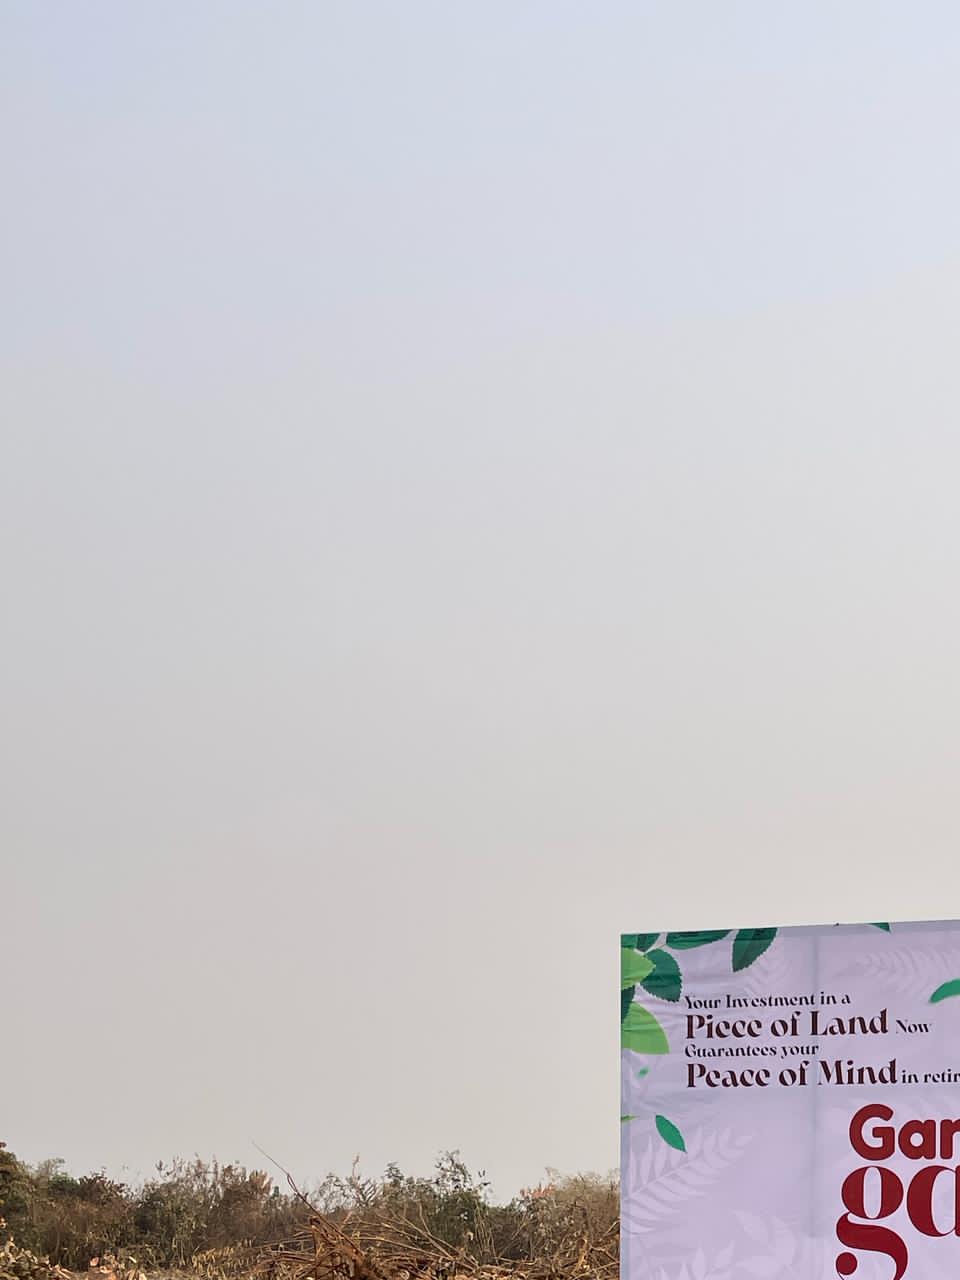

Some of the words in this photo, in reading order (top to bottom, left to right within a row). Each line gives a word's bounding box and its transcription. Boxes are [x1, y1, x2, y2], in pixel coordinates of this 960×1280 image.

[684, 995, 722, 1010] Your
[725, 994, 815, 1008] Investment
[820, 992, 838, 1005] in
[841, 994, 851, 1005] a
[686, 1013, 763, 1039] Piece
[770, 1011, 801, 1037] of
[809, 1008, 889, 1036] Land
[896, 1019, 932, 1034] Now
[684, 1044, 777, 1058] Guarantees
[780, 1043, 820, 1059] your
[686, 1062, 770, 1088] Peace
[778, 1060, 809, 1087] of
[816, 1058, 898, 1086] Mind
[901, 1070, 919, 1084] in
